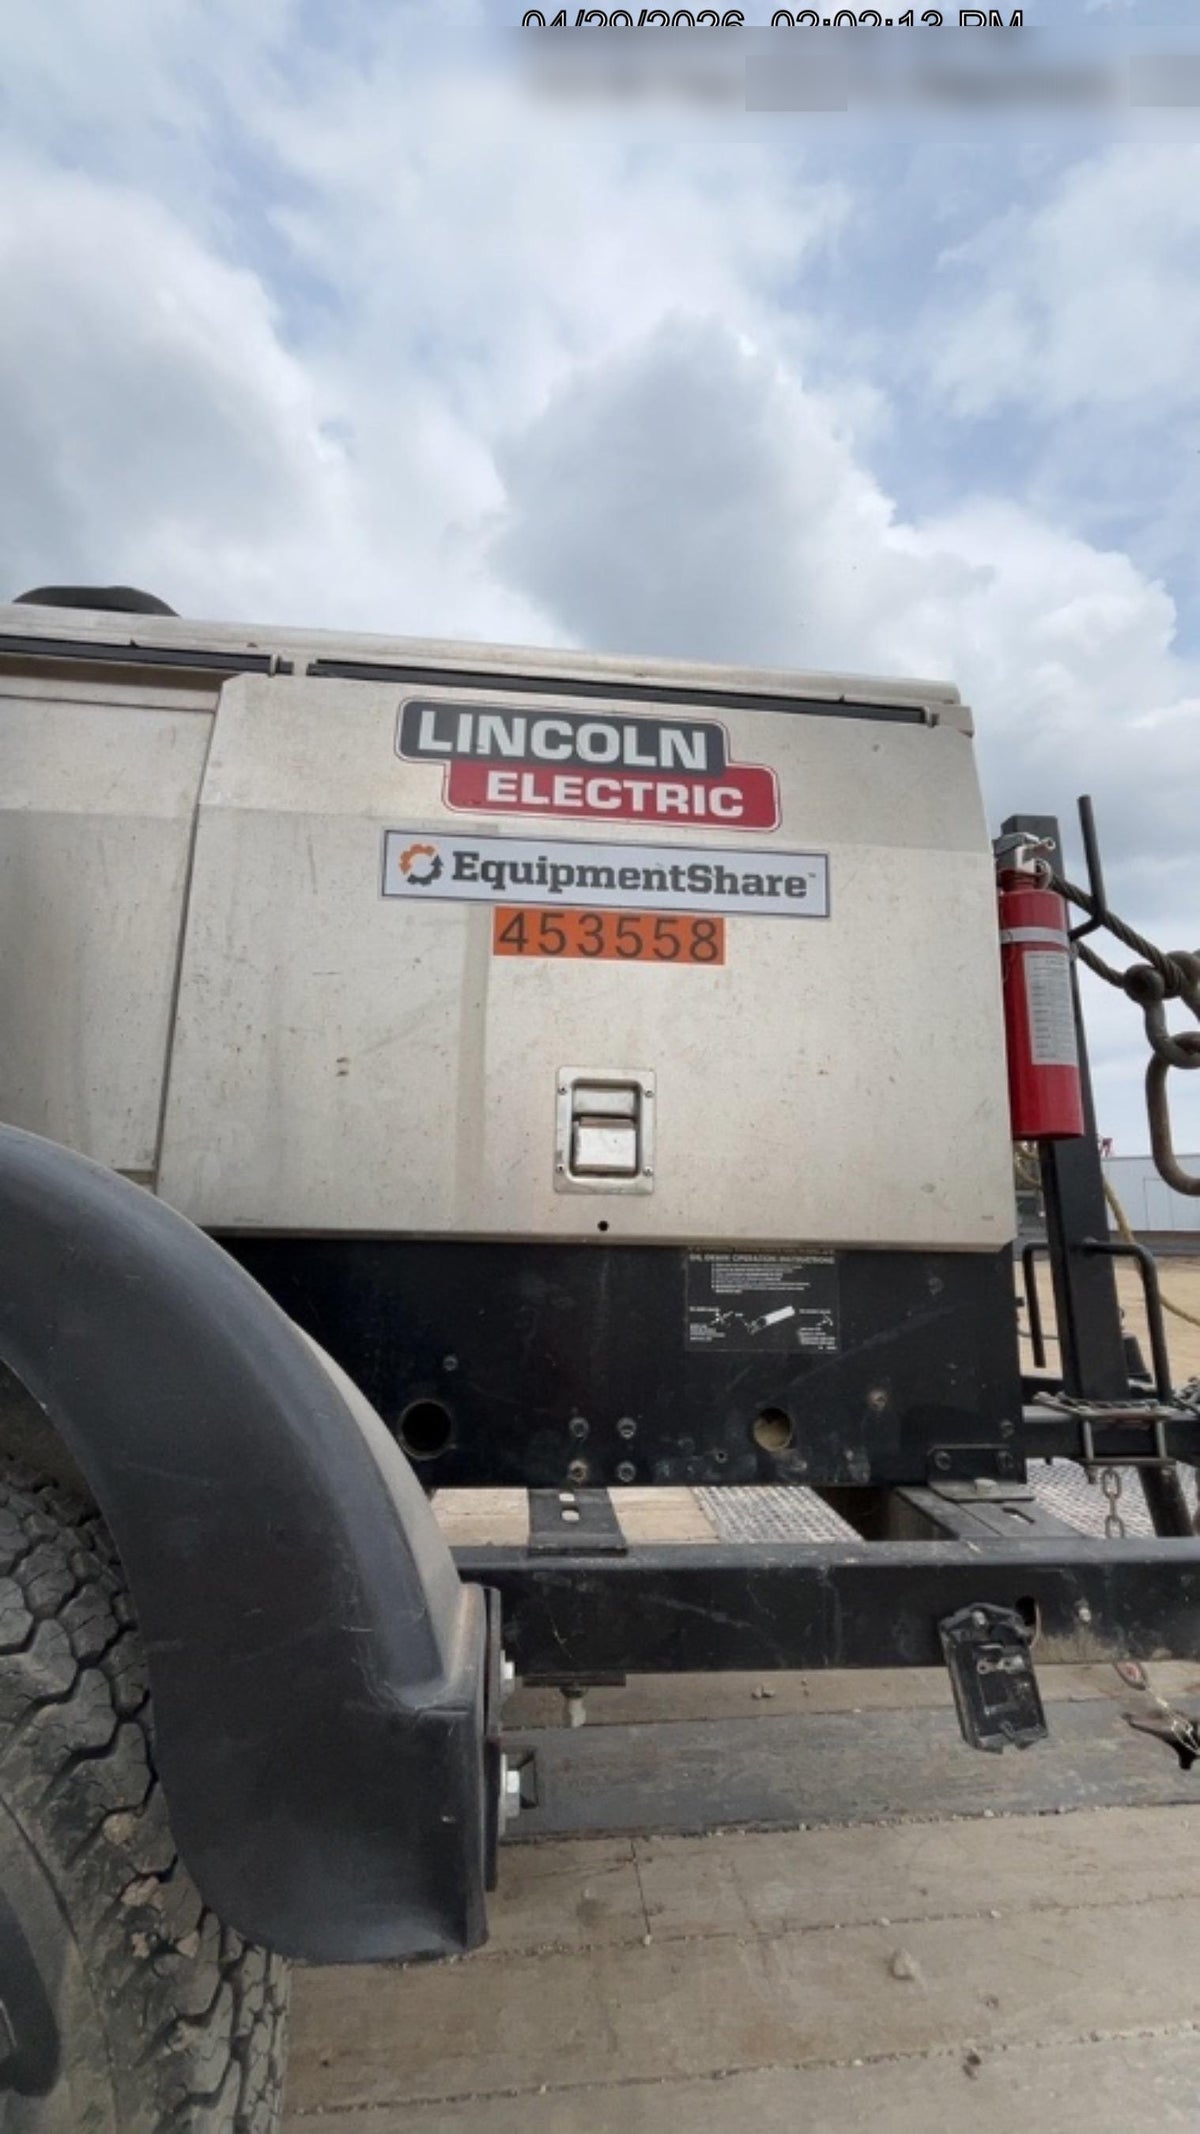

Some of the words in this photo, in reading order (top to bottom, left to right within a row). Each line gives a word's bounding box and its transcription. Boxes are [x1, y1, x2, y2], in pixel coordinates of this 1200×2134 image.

[417, 710, 708, 770] LINCOLN
[487, 771, 744, 818] ELECTRIC
[499, 912, 718, 963] 453558
